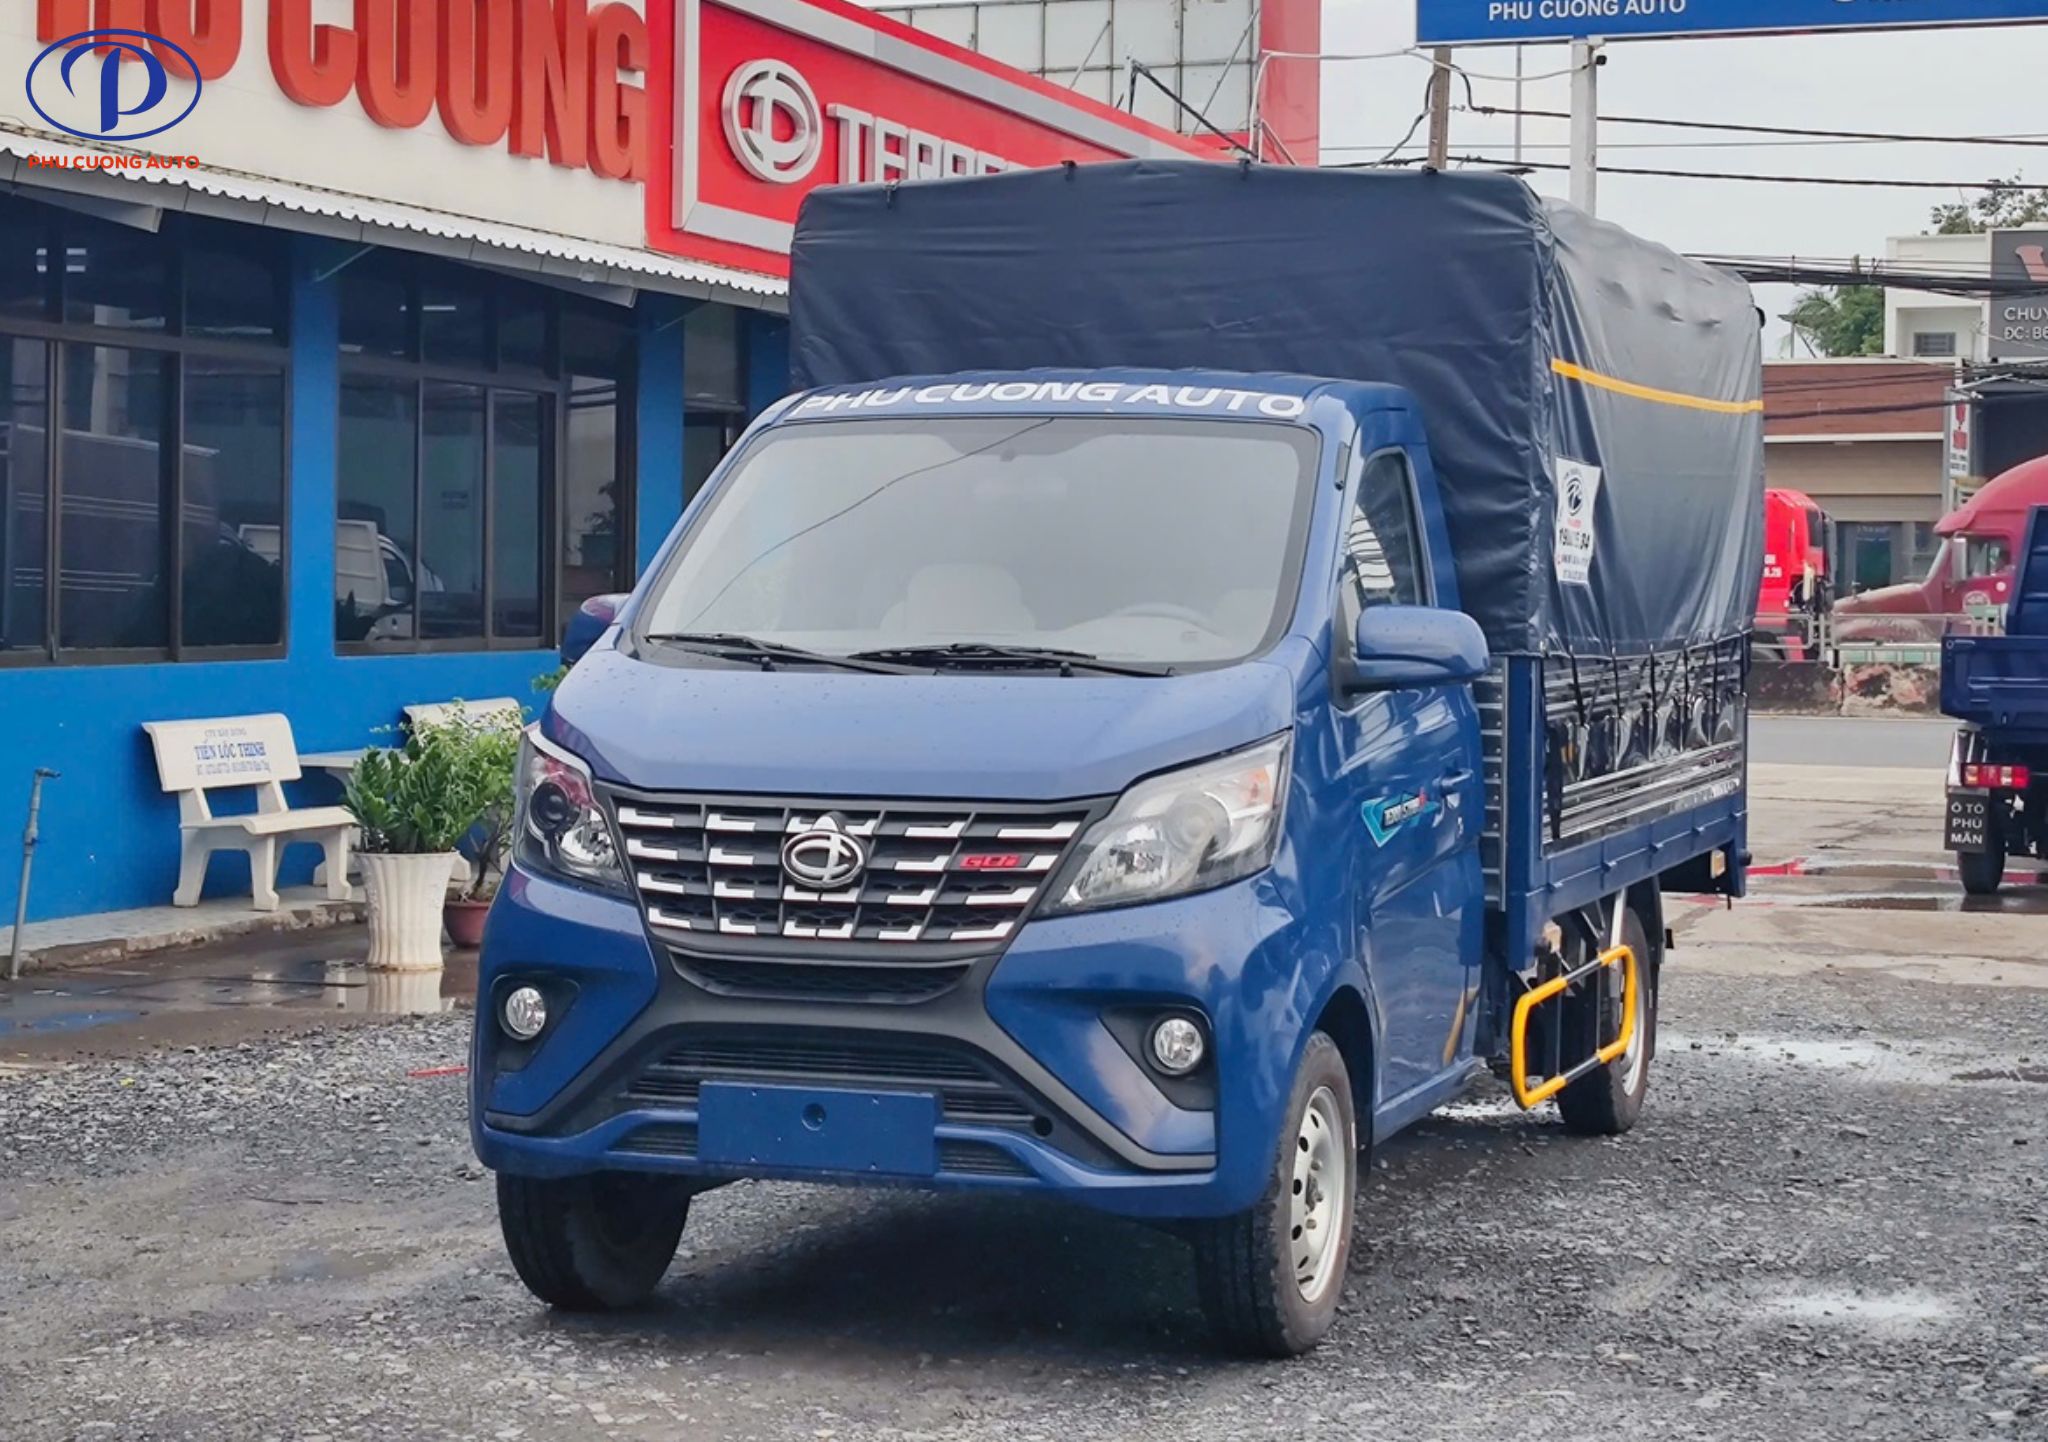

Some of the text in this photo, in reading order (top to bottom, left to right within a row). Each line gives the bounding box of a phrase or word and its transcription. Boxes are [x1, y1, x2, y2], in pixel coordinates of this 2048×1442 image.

[1624, 0, 1686, 14] AUTO
[790, 382, 1305, 417] PHU CUONG AUTO
